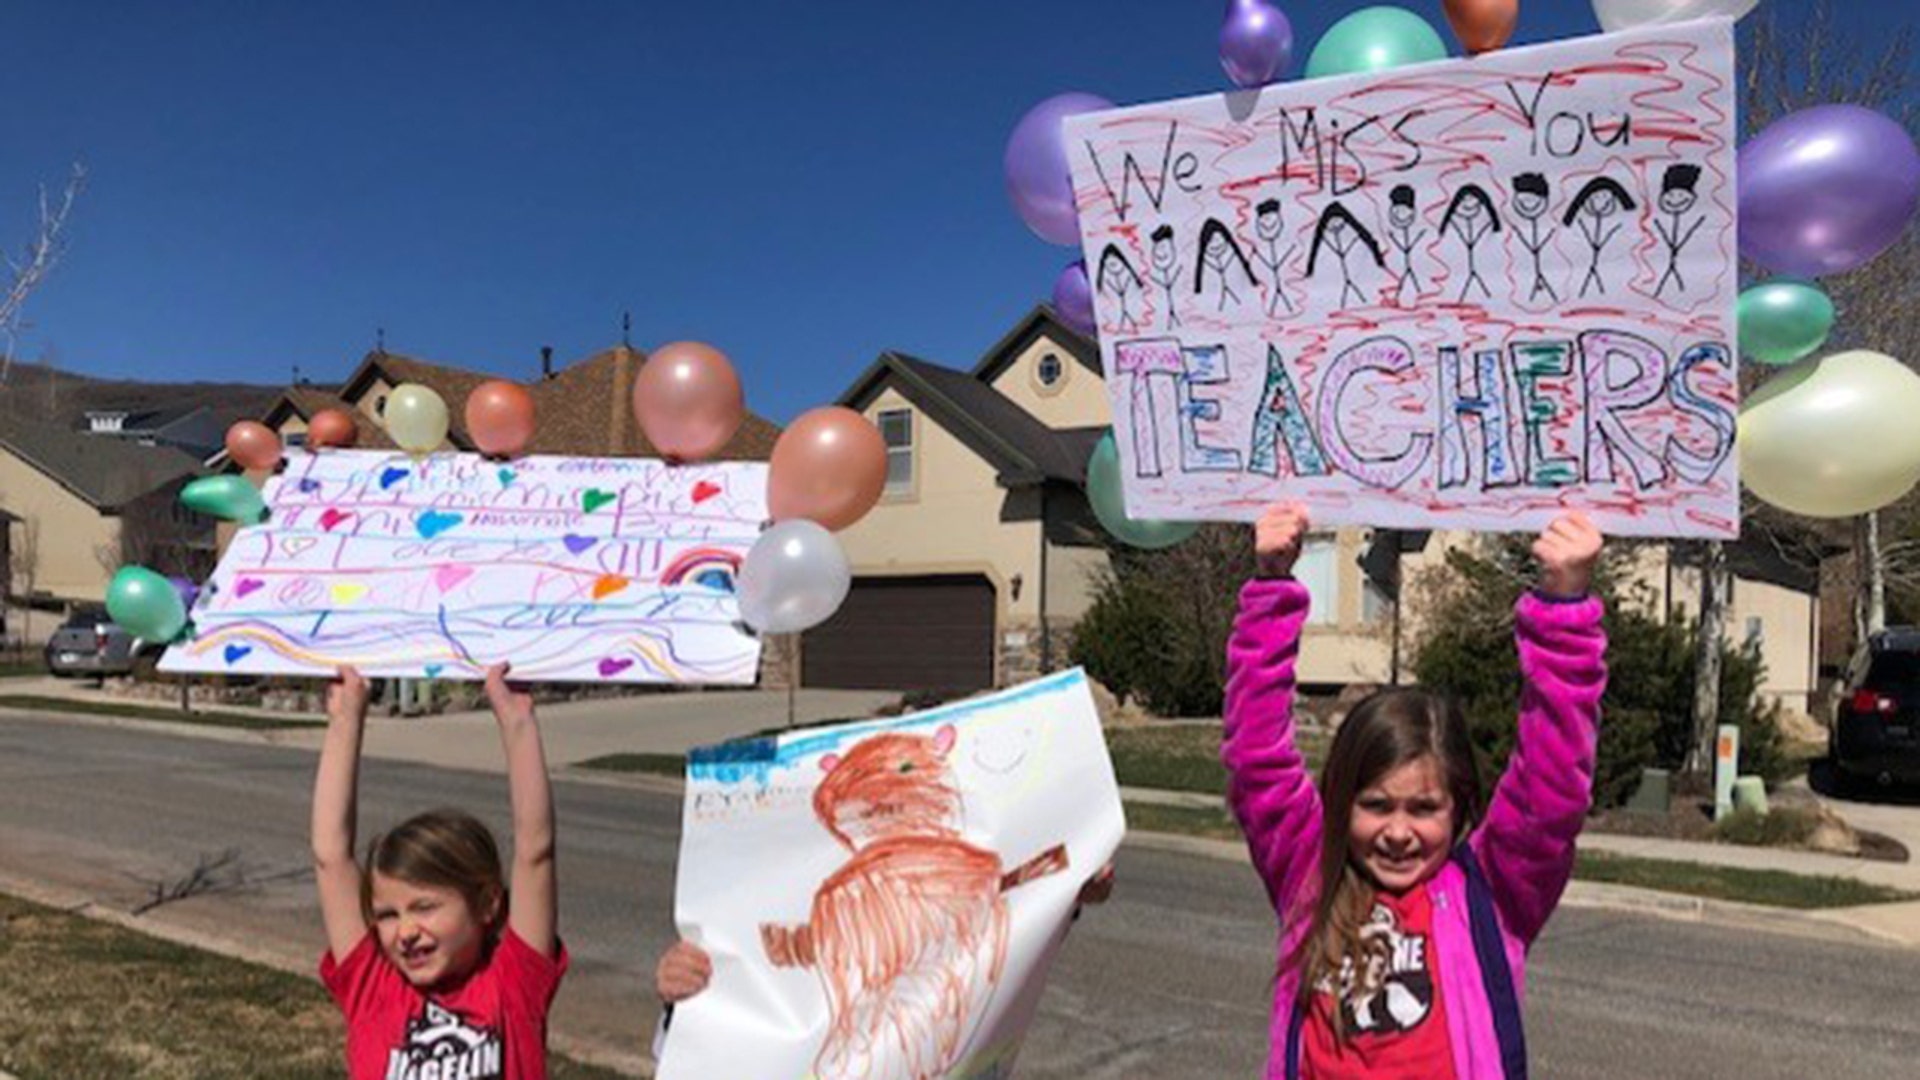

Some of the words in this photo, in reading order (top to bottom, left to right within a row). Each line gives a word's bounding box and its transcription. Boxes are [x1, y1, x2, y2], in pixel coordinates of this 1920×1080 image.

[1085, 119, 1202, 222] We
[1279, 106, 1425, 196] Miss
[1506, 71, 1630, 157] You
[1114, 329, 1737, 491] TEACHERS
